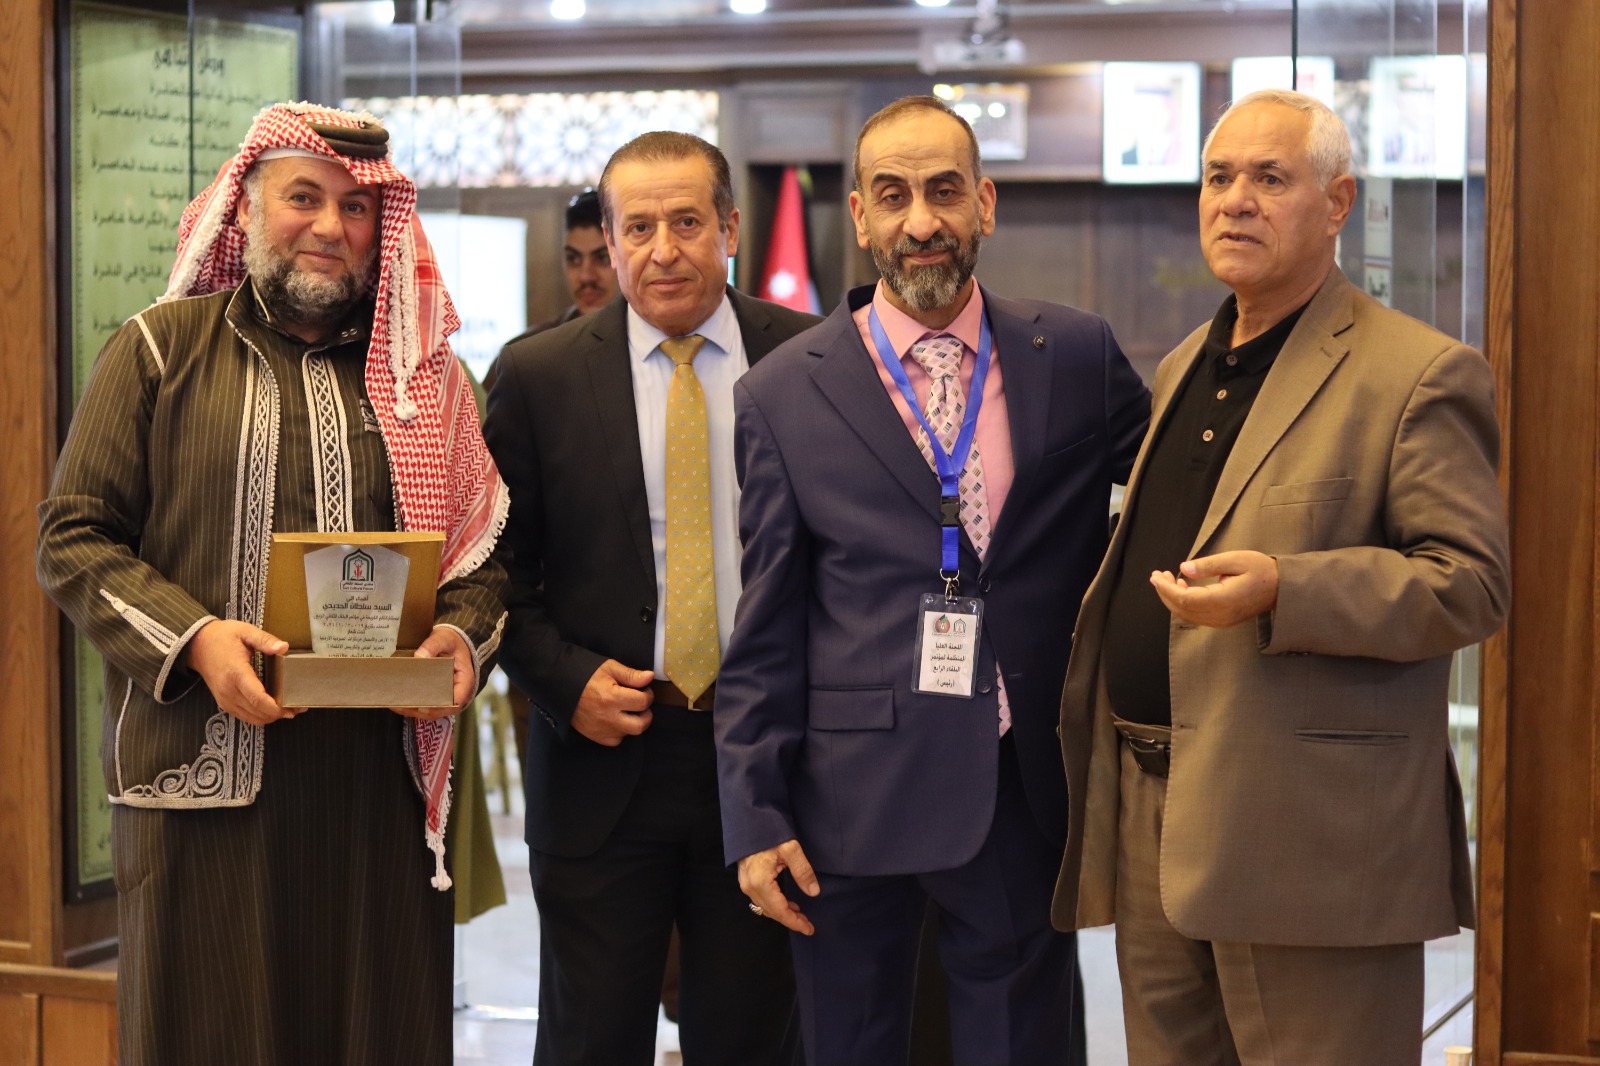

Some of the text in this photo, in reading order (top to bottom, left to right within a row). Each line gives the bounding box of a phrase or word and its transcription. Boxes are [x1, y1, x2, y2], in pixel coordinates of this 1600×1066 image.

[350, 602, 371, 610] سلطان
[373, 603, 392, 612] السيد
[935, 642, 963, 652] اللجنة العليا
[932, 664, 946, 673] الرابع
